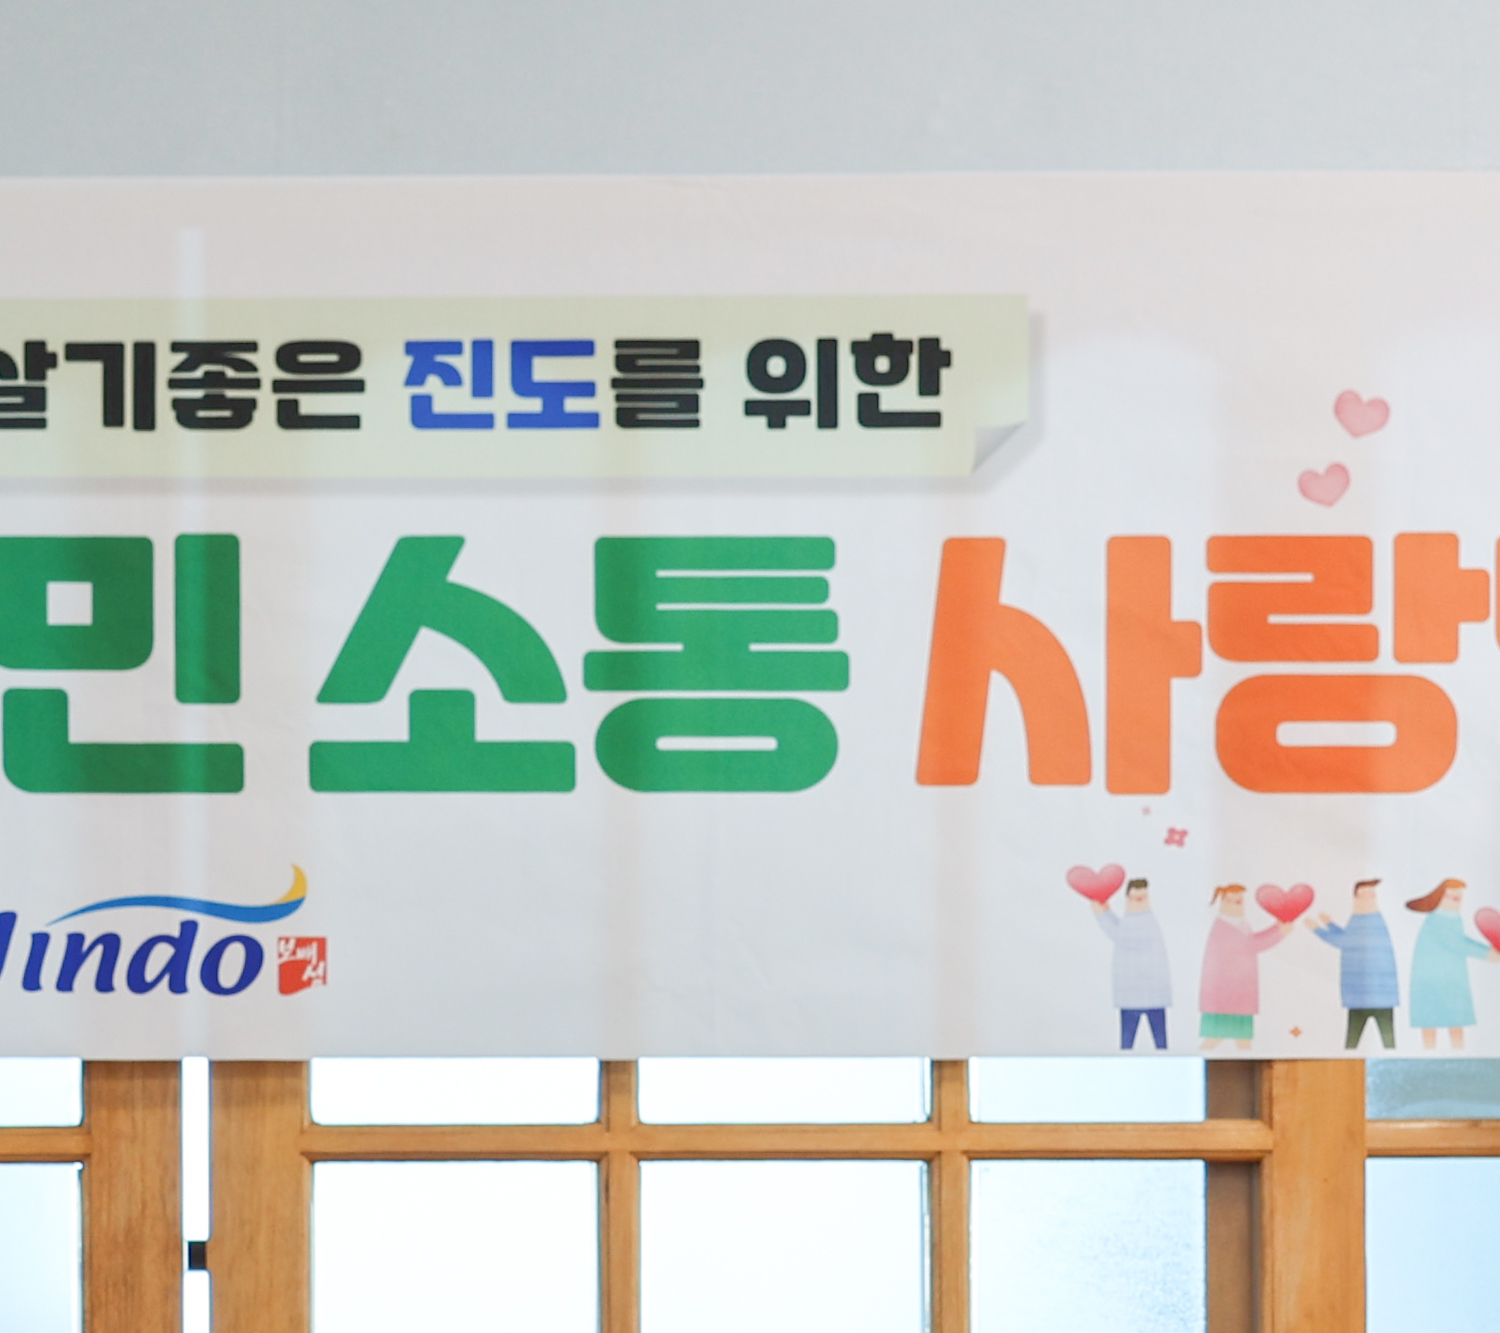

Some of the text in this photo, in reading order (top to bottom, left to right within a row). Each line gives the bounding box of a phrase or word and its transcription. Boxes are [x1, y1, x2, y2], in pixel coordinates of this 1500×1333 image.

[403, 337, 704, 431] 진도를
[744, 331, 951, 430] 위한
[308, 534, 850, 794] 소통
